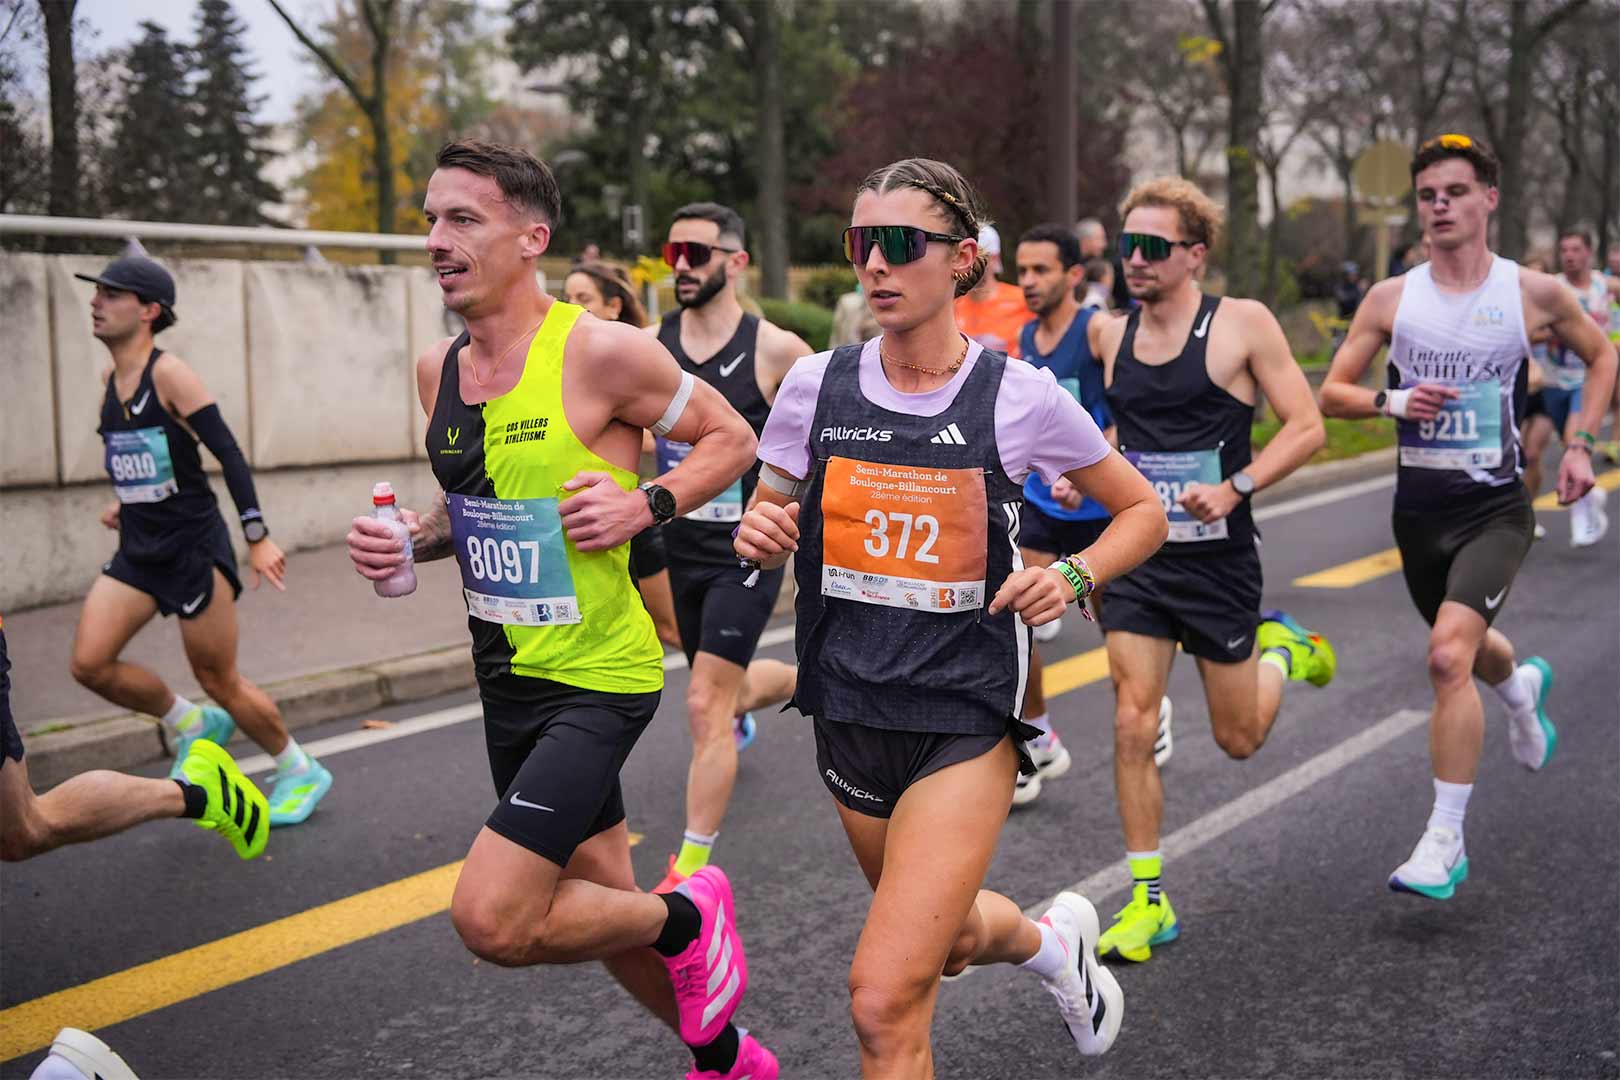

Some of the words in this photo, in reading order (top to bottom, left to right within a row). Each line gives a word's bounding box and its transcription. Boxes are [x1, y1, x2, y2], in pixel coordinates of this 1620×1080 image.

[506, 421, 518, 432] COS
[520, 418, 549, 430] VILLERS
[1418, 409, 1480, 441] 9211
[504, 430, 546, 445] ATHLÉTISME
[820, 426, 893, 442] Alltricks
[111, 451, 157, 481] 9810
[855, 464, 932, 480] Semi-Marathon
[934, 471, 948, 482] de
[849, 476, 957, 494] Boulogne-Billancourt
[463, 498, 513, 511] Semi-Marathon
[514, 501, 525, 511] de
[902, 491, 933, 504] édition
[462, 508, 535, 521] Boulogne-Billancourt
[864, 509, 940, 564] 372
[467, 535, 540, 584] 8097
